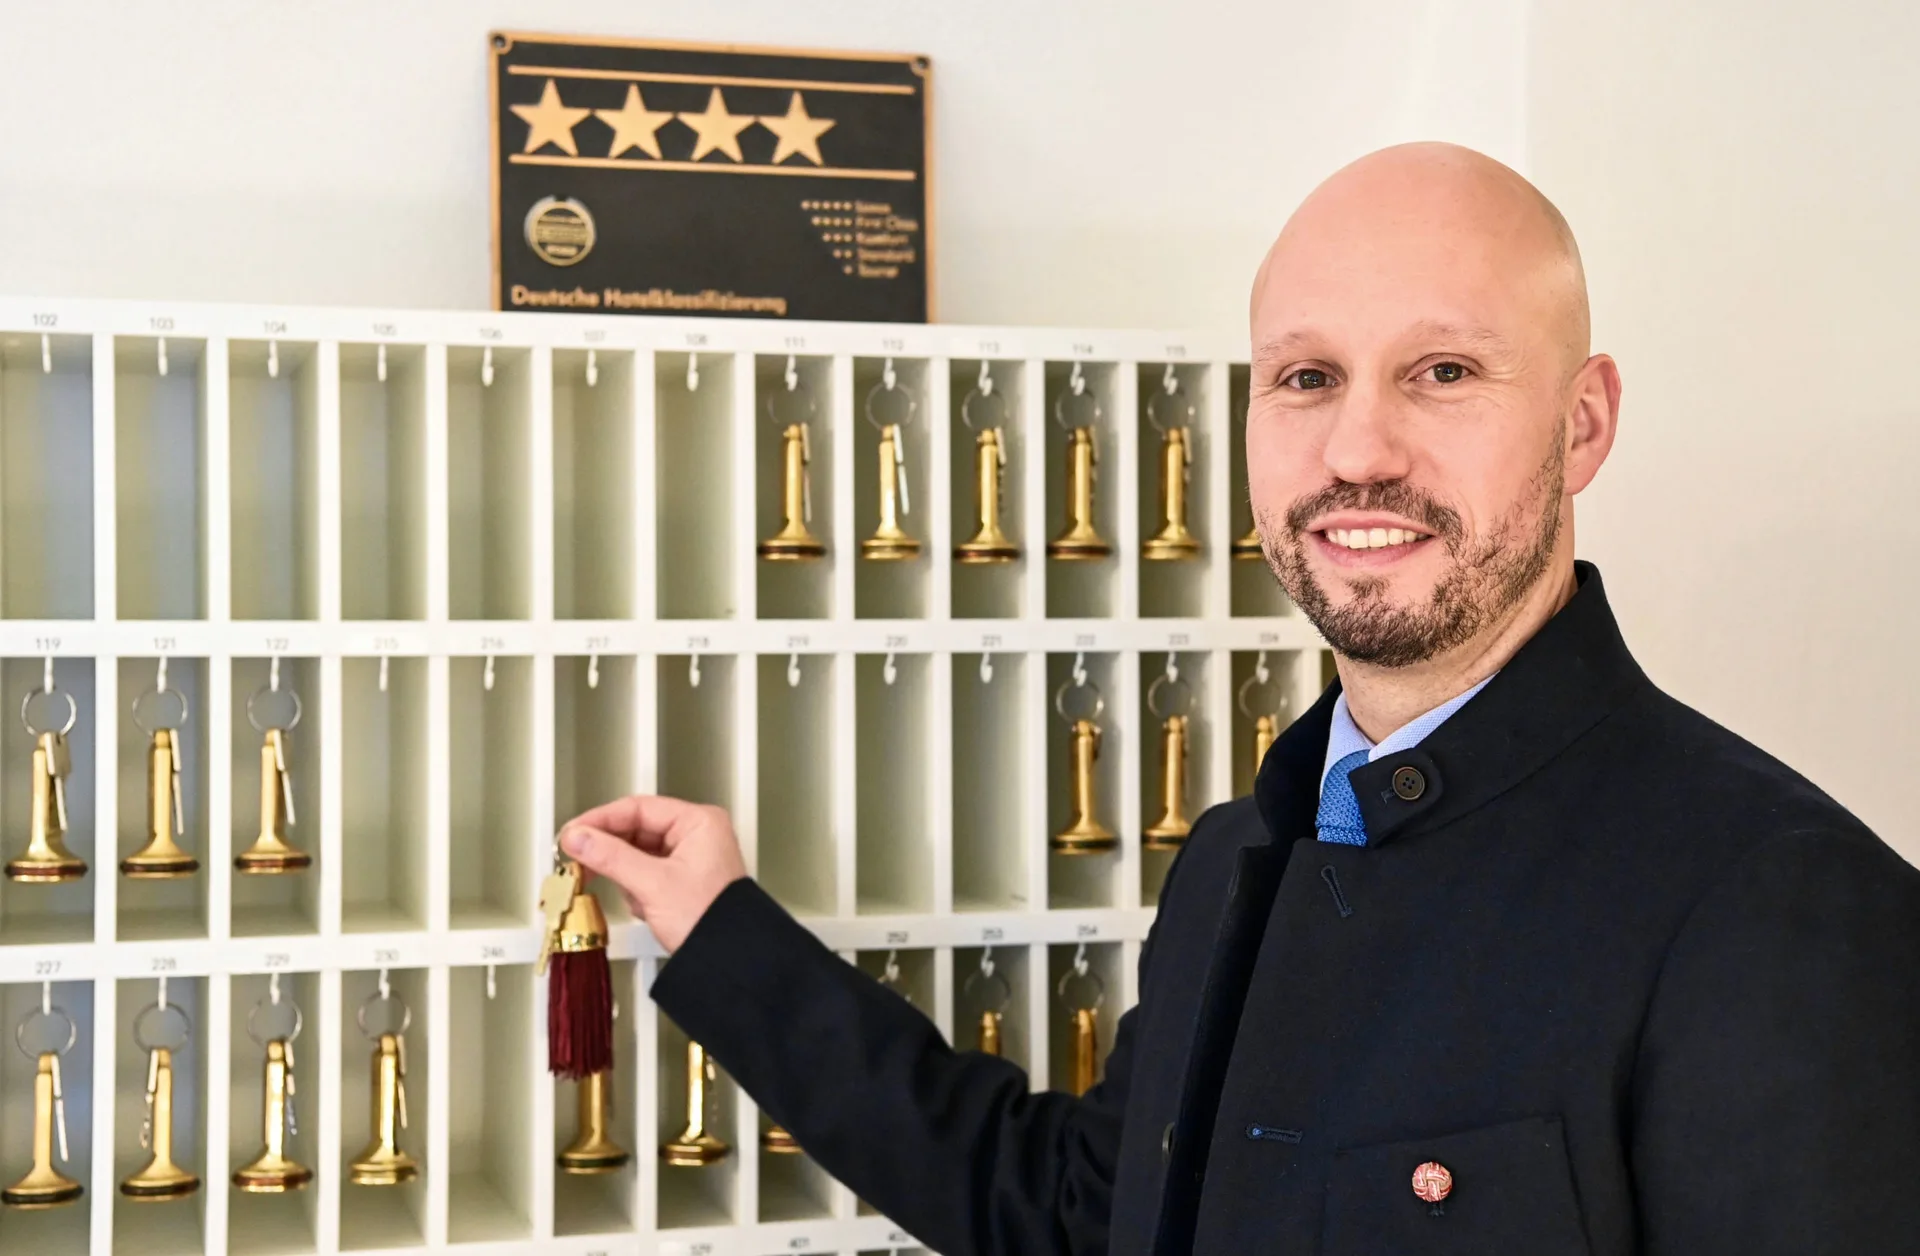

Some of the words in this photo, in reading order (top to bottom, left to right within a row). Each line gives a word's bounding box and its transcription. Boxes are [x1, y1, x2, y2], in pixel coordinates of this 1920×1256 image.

[511, 285, 599, 308] Deutsche
[604, 287, 787, 315] Hotelklassifizierung
[33, 313, 58, 327] 102
[150, 317, 175, 331] 103
[264, 322, 287, 333] 104
[784, 336, 806, 349] 111
[883, 339, 904, 352] 112
[1073, 344, 1094, 354] 114
[36, 638, 61, 650] 119
[154, 637, 176, 650] 121
[266, 637, 289, 651] 122
[374, 637, 399, 650] 215
[481, 637, 505, 650] 216
[586, 636, 610, 650] 217
[688, 636, 710, 648] 218
[788, 635, 810, 648] 219
[982, 635, 1002, 647] 221
[152, 957, 177, 971] 228
[265, 953, 290, 967] 229
[36, 961, 61, 975] 227
